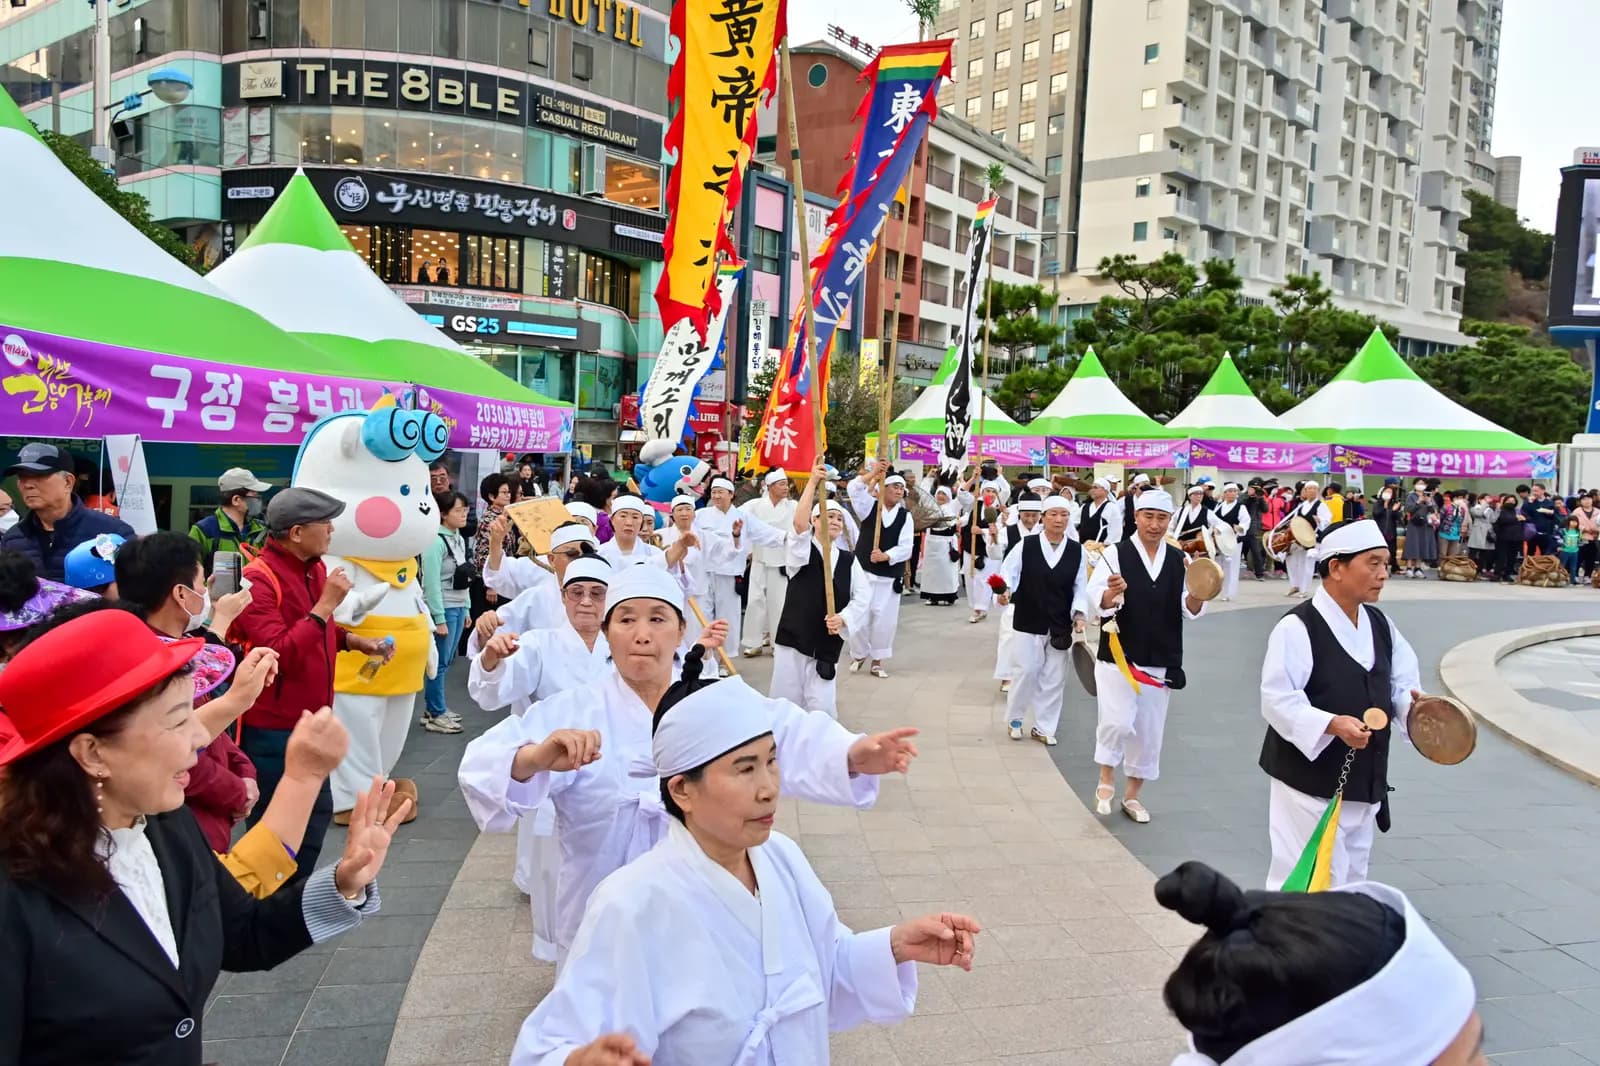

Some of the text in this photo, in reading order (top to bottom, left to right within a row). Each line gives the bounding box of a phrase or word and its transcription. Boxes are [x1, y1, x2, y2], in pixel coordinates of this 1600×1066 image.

[296, 64, 389, 98] THE
[541, 111, 638, 147] CASUAL RESTAURANT
[375, 182, 470, 213] 무신명품
[473, 192, 557, 226] 민물장어
[451, 315, 499, 334] GS25
[146, 364, 243, 431] 구정
[477, 402, 546, 429] 2030세계박람회
[700, 413, 720, 422] LITER
[470, 424, 551, 449] 부산유치기원 홍보관
[1227, 446, 1295, 464] 설문조사
[1391, 451, 1508, 475] 종합안내소
